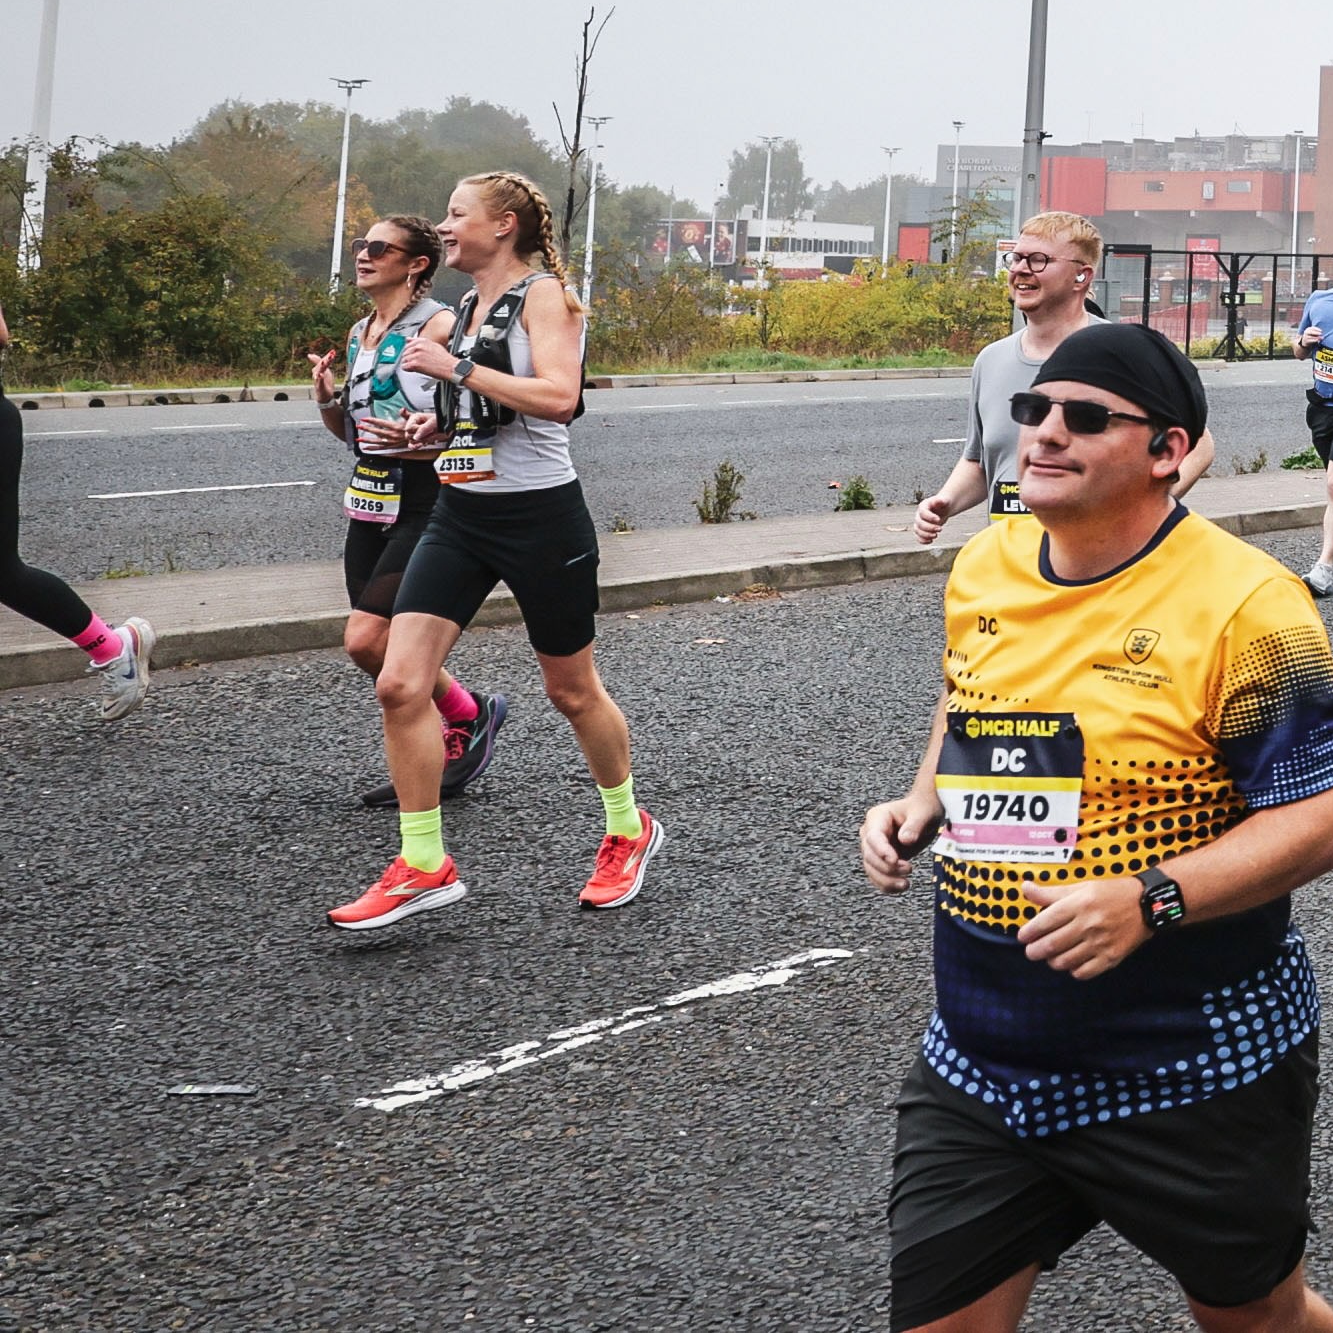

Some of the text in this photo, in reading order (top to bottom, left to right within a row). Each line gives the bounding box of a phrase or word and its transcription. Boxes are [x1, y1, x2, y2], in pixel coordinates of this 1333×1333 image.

[440, 457, 474, 471] 23135
[350, 496, 384, 513] 19269
[978, 615, 998, 636] DC
[1092, 663, 1174, 684] KINGSTON UPON HULL
[1103, 674, 1159, 689] ATHLETIC CLUB
[981, 720, 1061, 738] MCR HALF
[990, 747, 1027, 773] DC
[963, 793, 1050, 823] 19740
